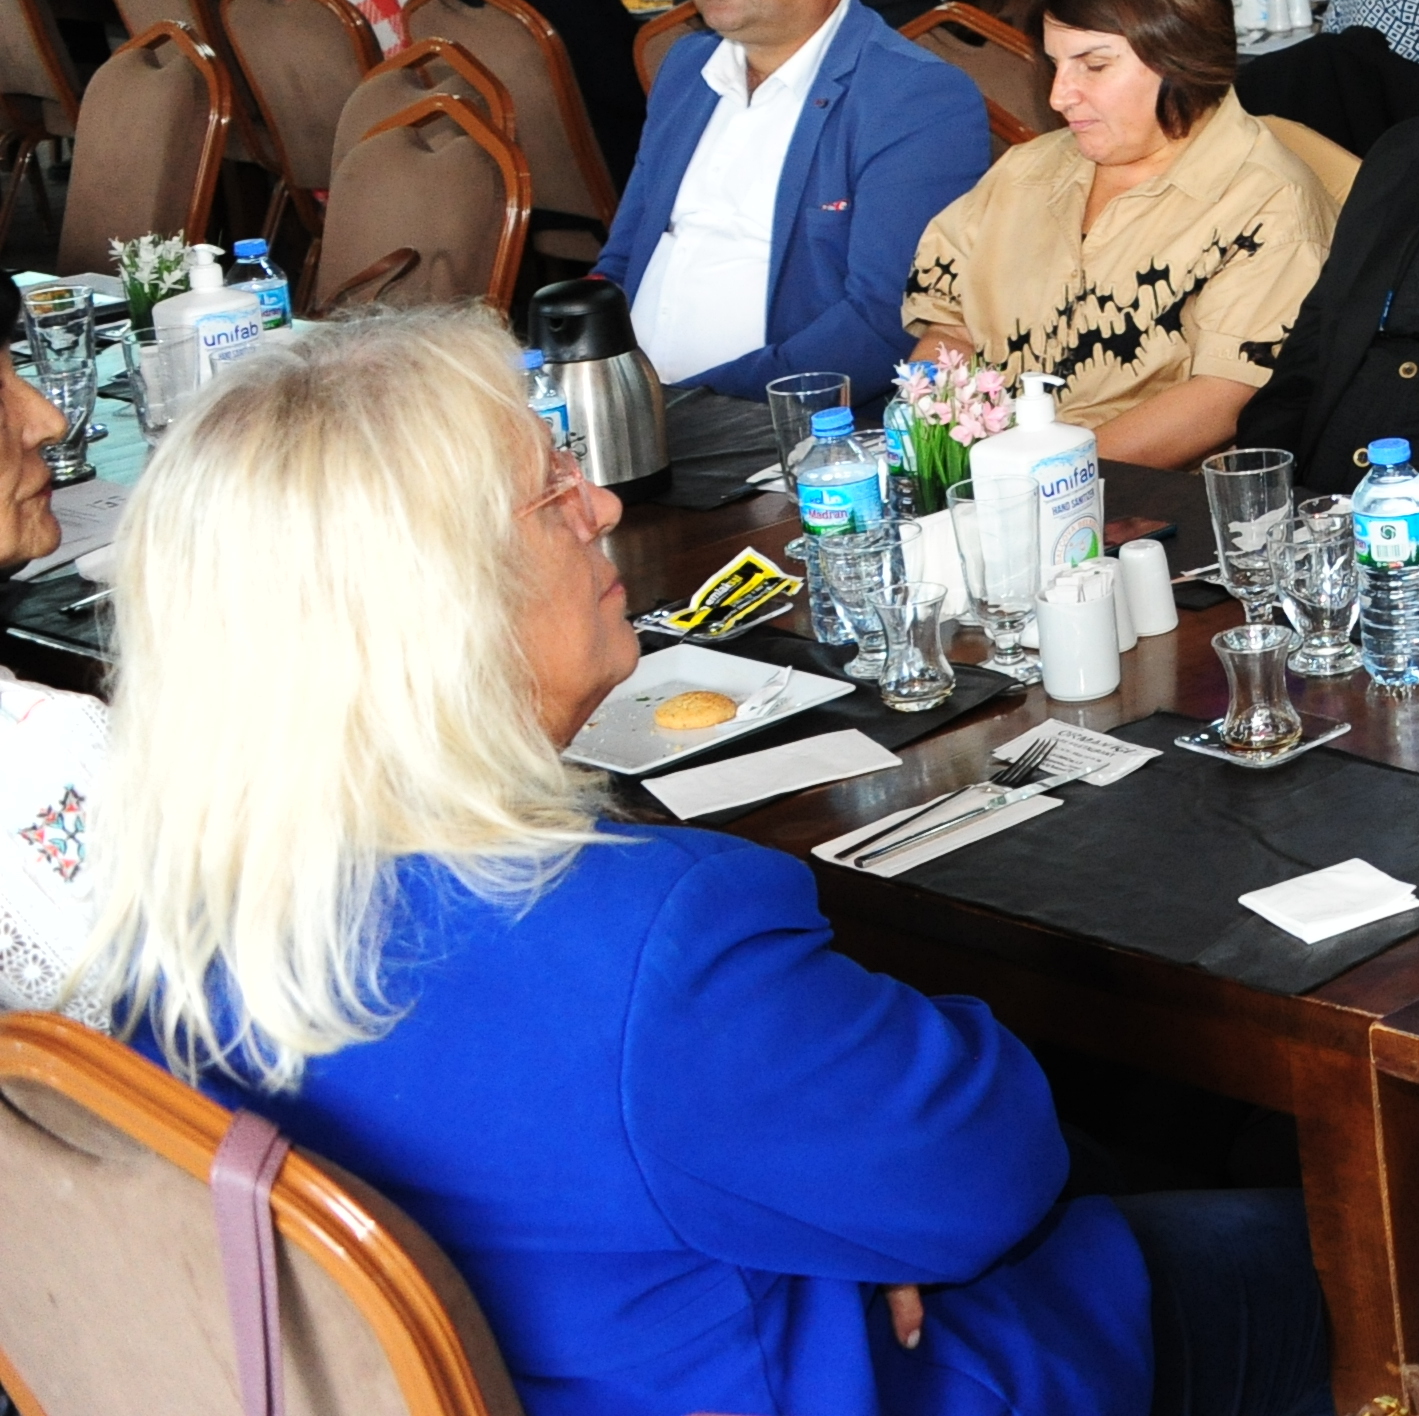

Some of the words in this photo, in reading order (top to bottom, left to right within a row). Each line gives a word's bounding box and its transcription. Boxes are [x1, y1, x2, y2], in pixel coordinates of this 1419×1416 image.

[203, 321, 260, 348] unifab
[1041, 459, 1096, 498] unifab
[808, 509, 849, 521] Madran
